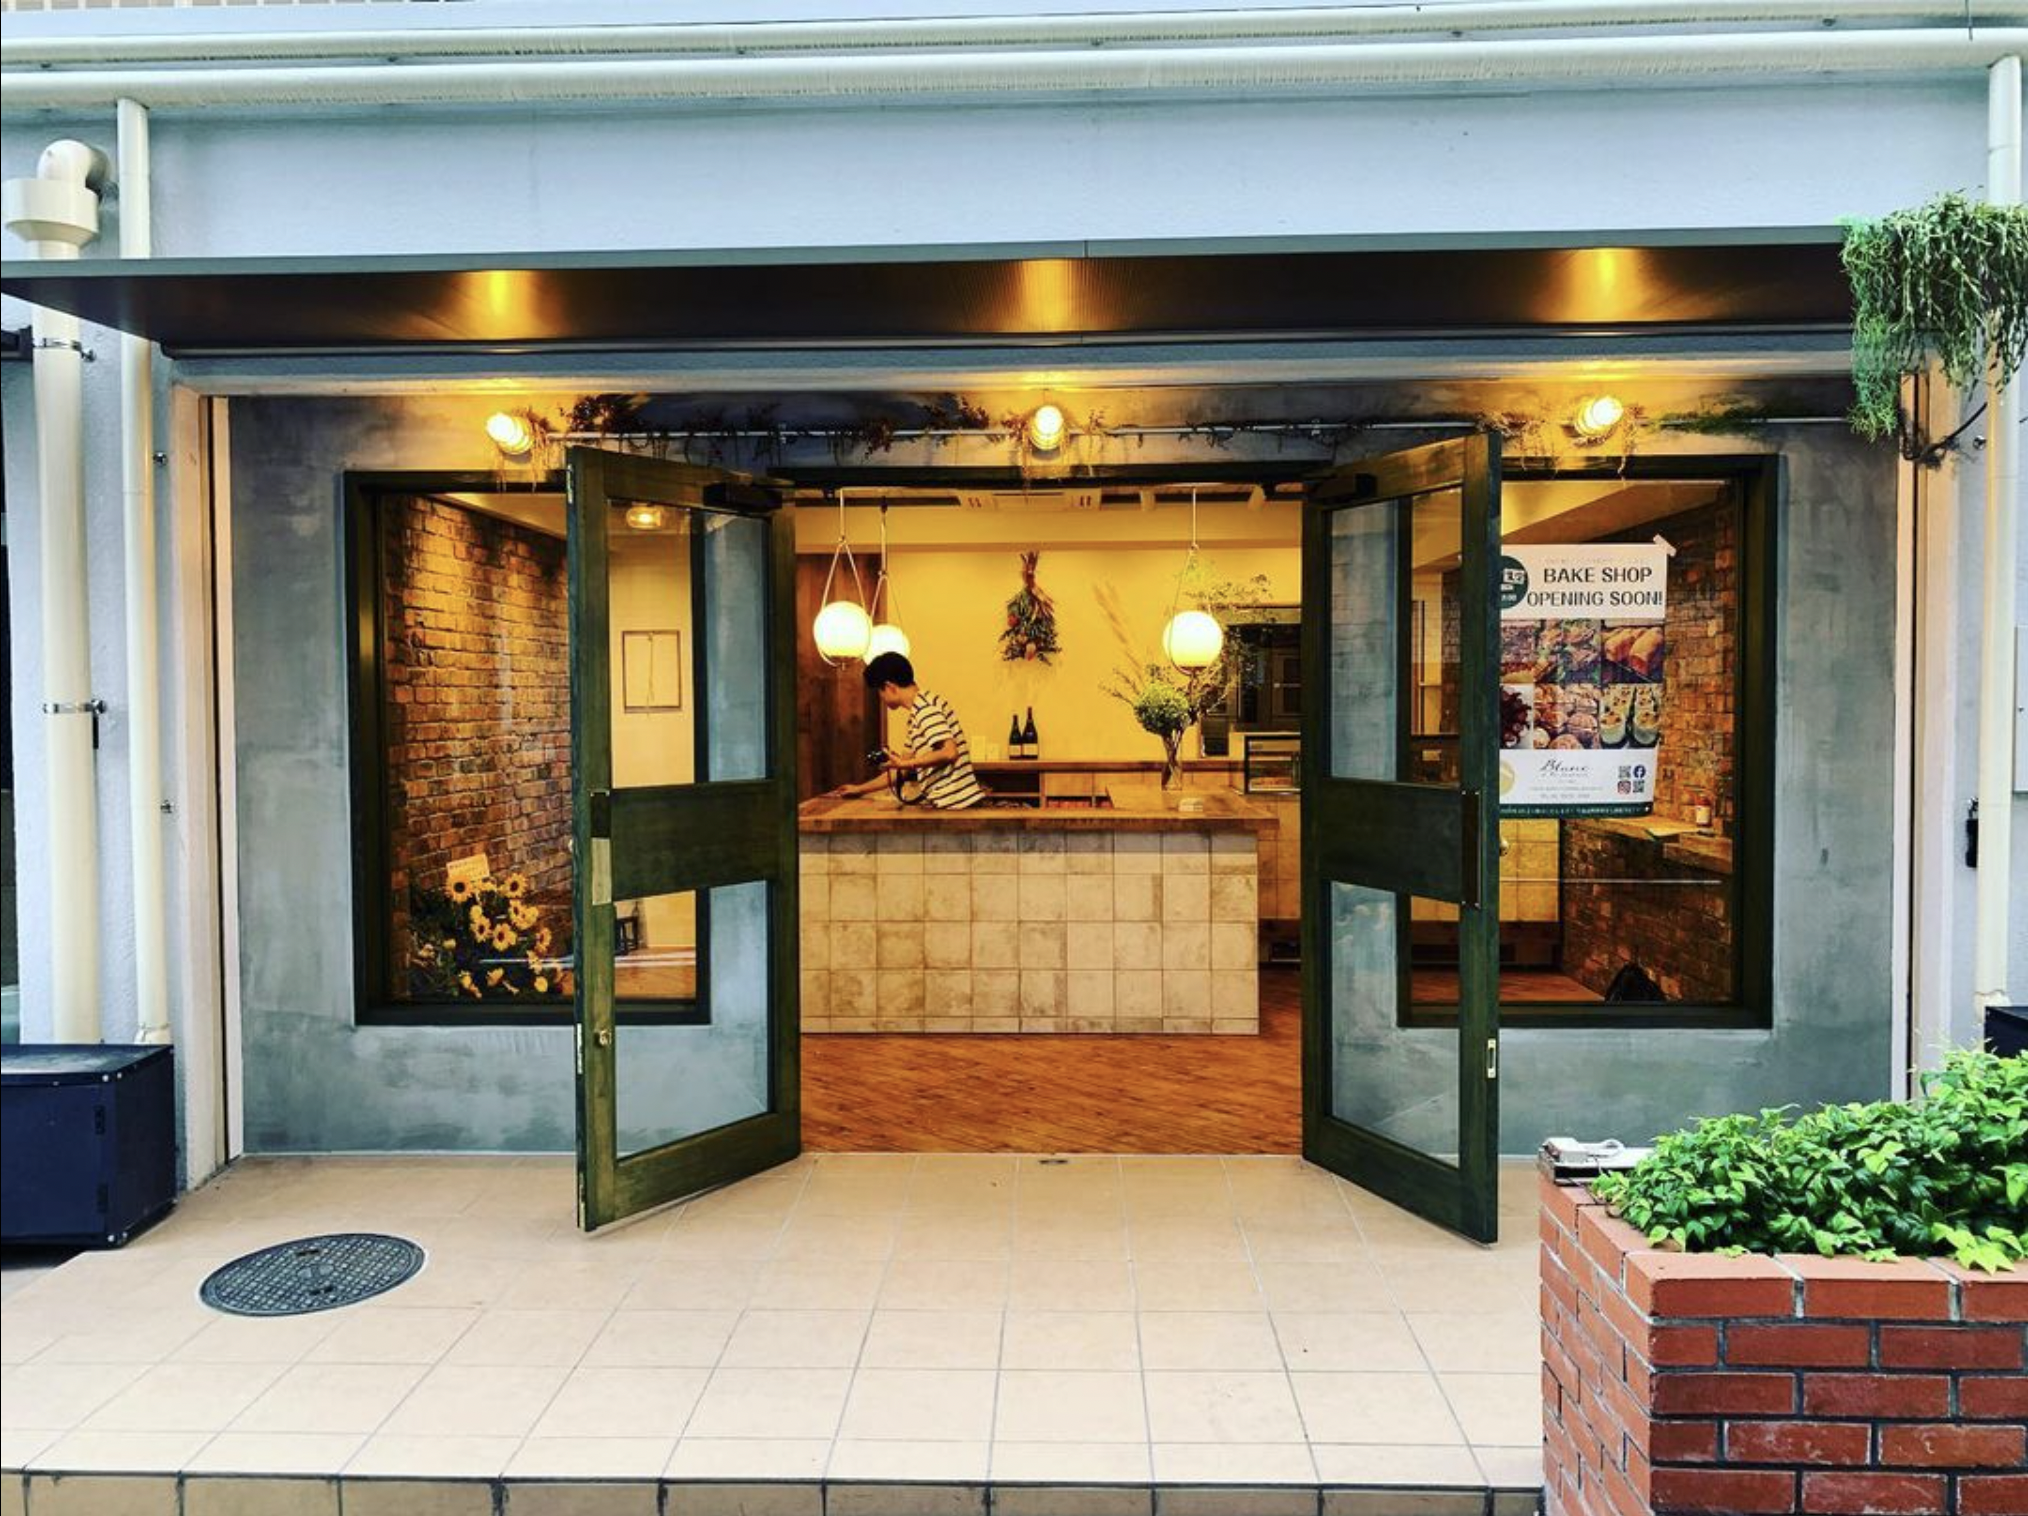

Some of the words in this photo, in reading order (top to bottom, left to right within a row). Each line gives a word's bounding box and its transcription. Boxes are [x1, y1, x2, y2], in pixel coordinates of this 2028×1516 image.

[1543, 568, 1595, 583] BAKE
[1602, 567, 1653, 583] SHOP
[1527, 591, 1604, 606] OPENING
[1610, 590, 1663, 606] SOON!
